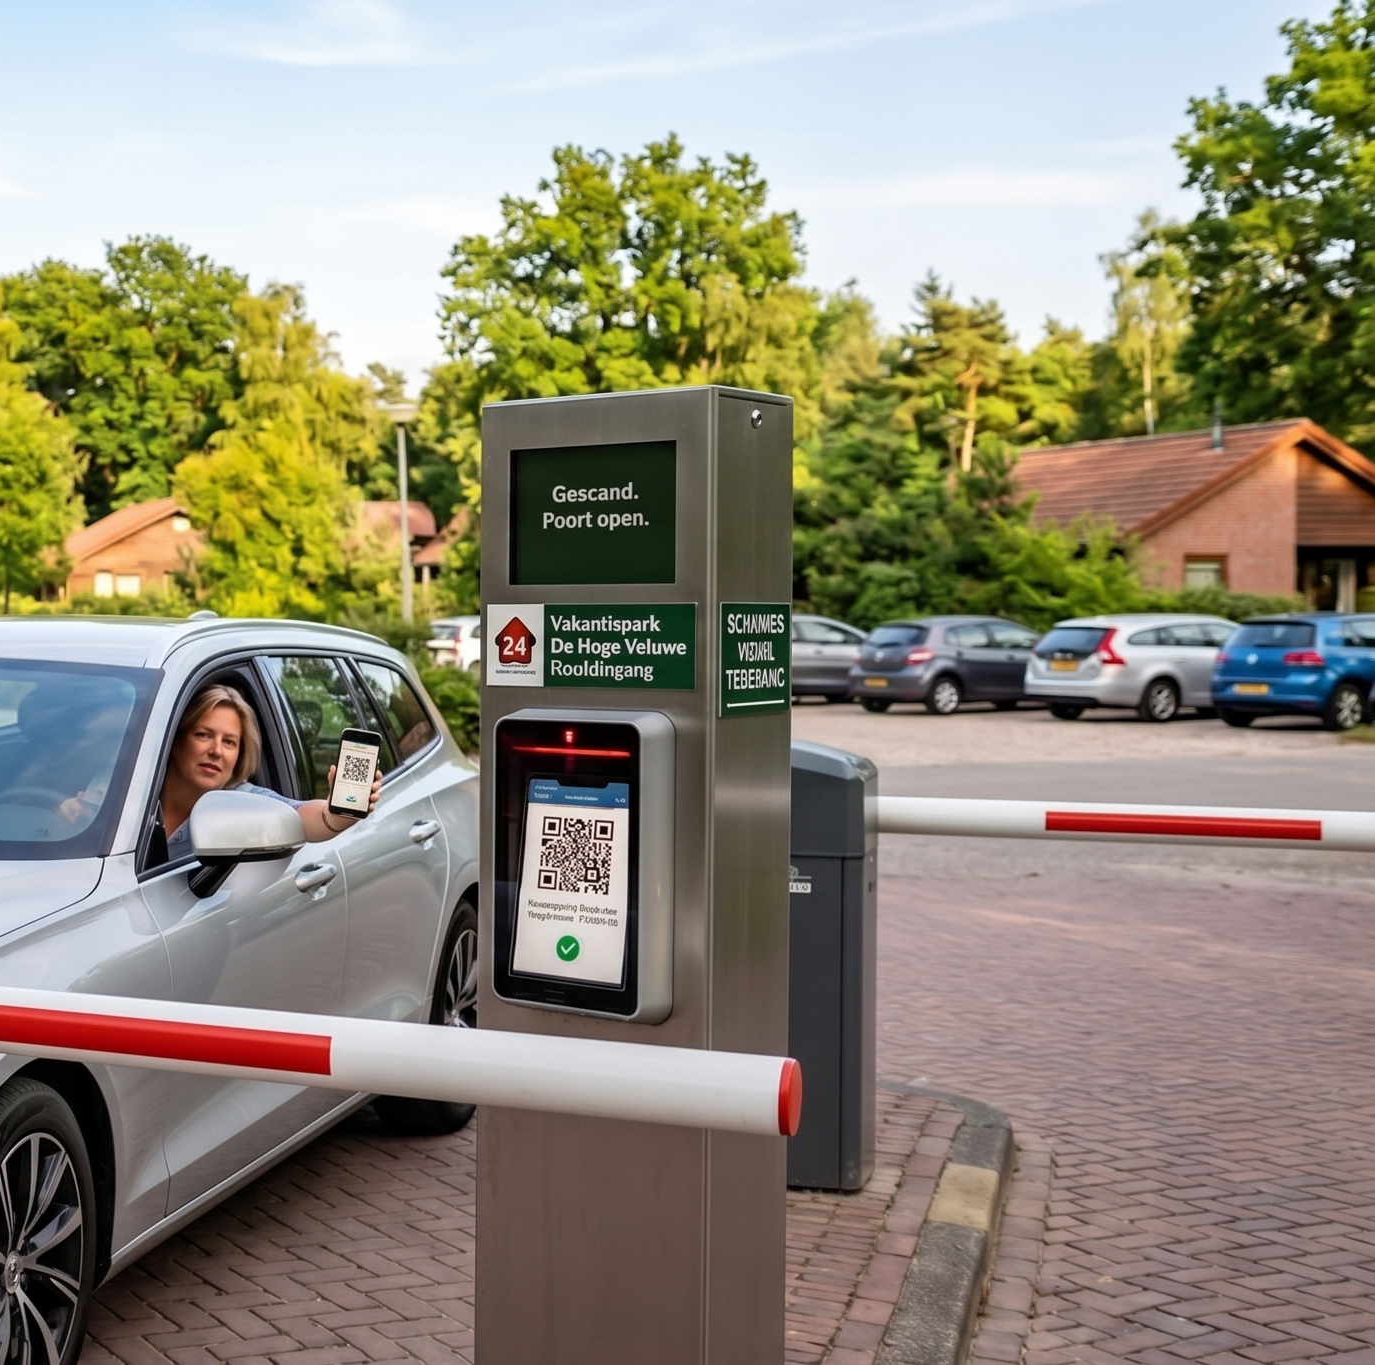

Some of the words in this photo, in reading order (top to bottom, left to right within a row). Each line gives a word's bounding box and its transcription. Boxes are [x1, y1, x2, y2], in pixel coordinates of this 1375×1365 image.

[552, 482, 639, 503] Gescand.
[542, 511, 593, 530] Poort
[597, 512, 650, 531] open.
[550, 615, 661, 636] Vakantispark
[502, 635, 527, 656] 24
[551, 638, 574, 655] De
[578, 638, 621, 658] Hoge
[624, 637, 687, 656] Veluwe
